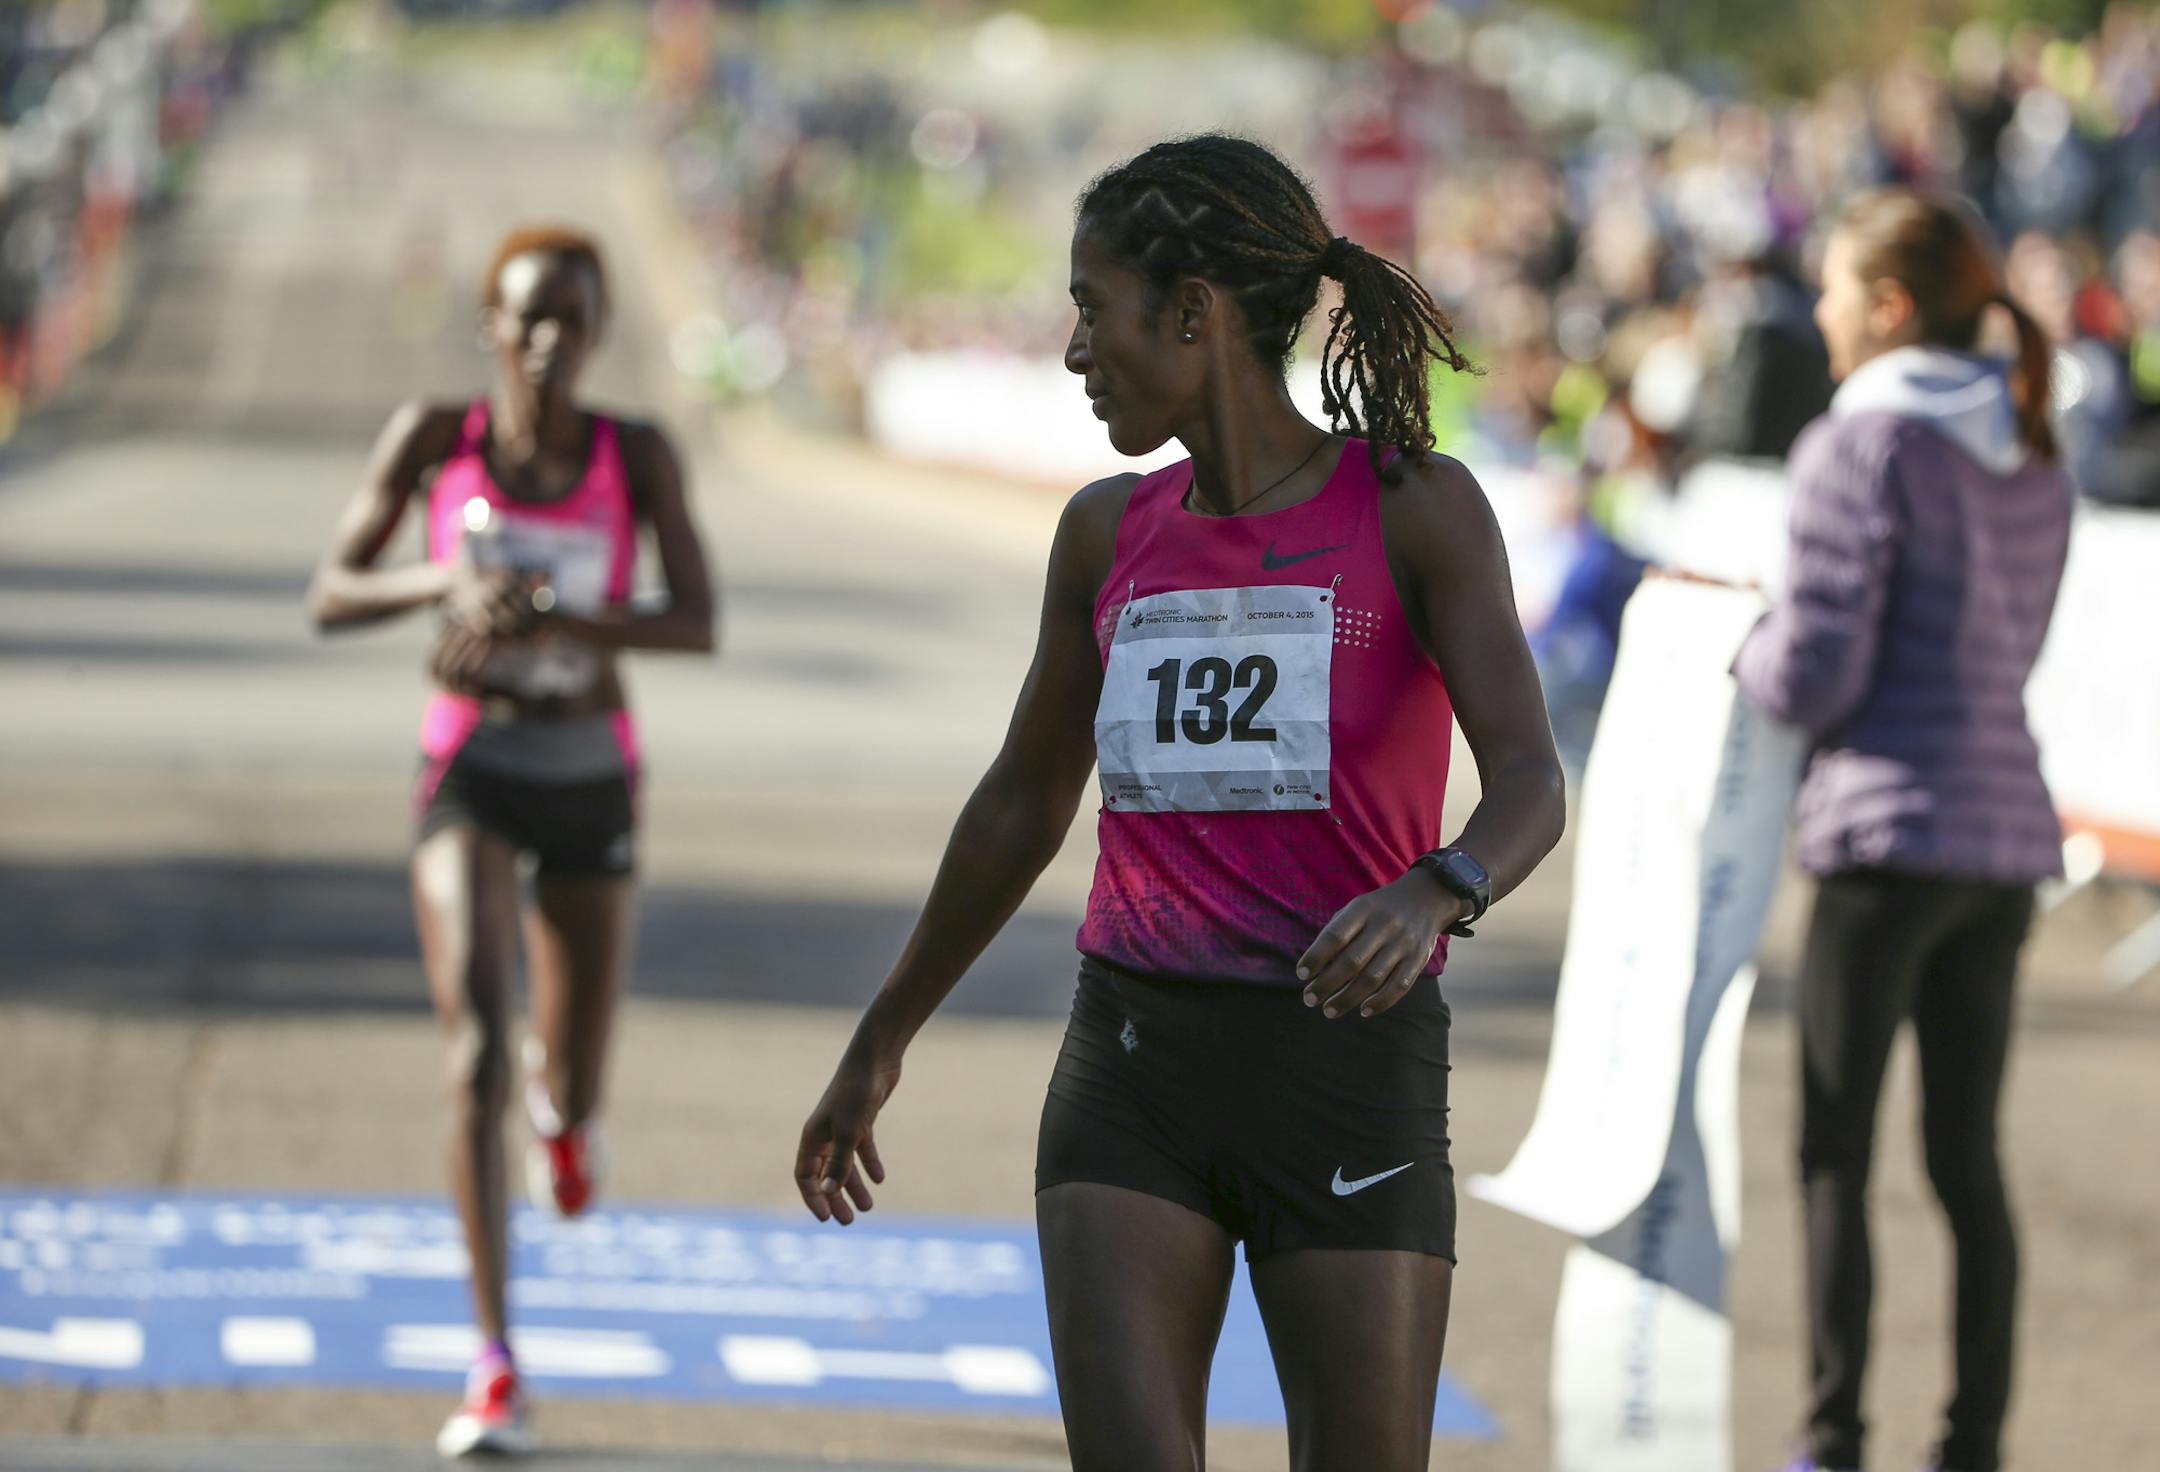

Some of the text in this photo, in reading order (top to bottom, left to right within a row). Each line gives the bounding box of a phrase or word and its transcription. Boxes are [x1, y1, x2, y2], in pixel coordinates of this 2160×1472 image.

[1146, 608, 1182, 618] MEDTRONIC
[1247, 611, 1315, 620] OCTOBER 4, 2015
[1144, 613, 1228, 625] TWIN CITIES MARATHON
[1147, 654, 1278, 745] 132
